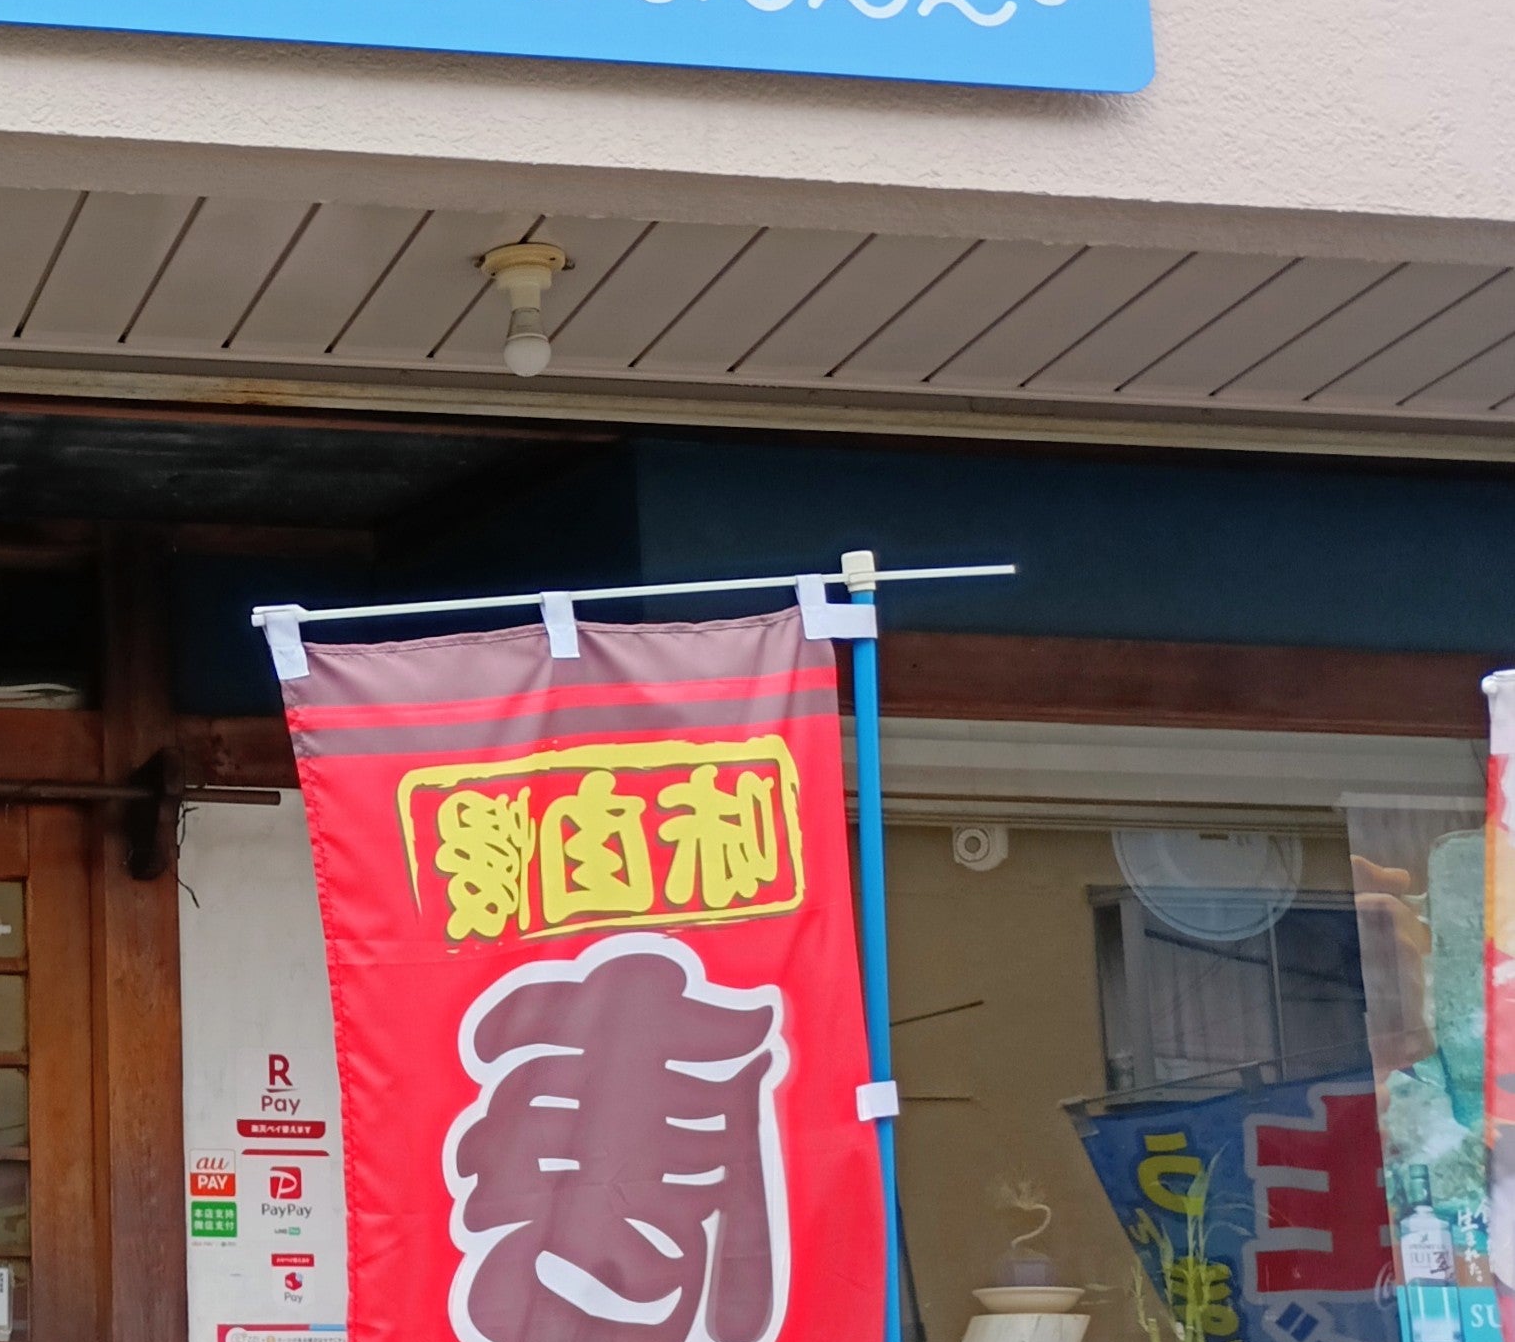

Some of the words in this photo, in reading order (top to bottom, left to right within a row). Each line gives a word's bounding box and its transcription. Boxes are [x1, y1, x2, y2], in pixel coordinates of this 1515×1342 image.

[261, 1095, 300, 1115] Pay
[196, 1156, 229, 1170] au
[197, 1174, 228, 1189] PAY
[261, 1203, 312, 1219] PayPay
[284, 1292, 303, 1303] Pay
